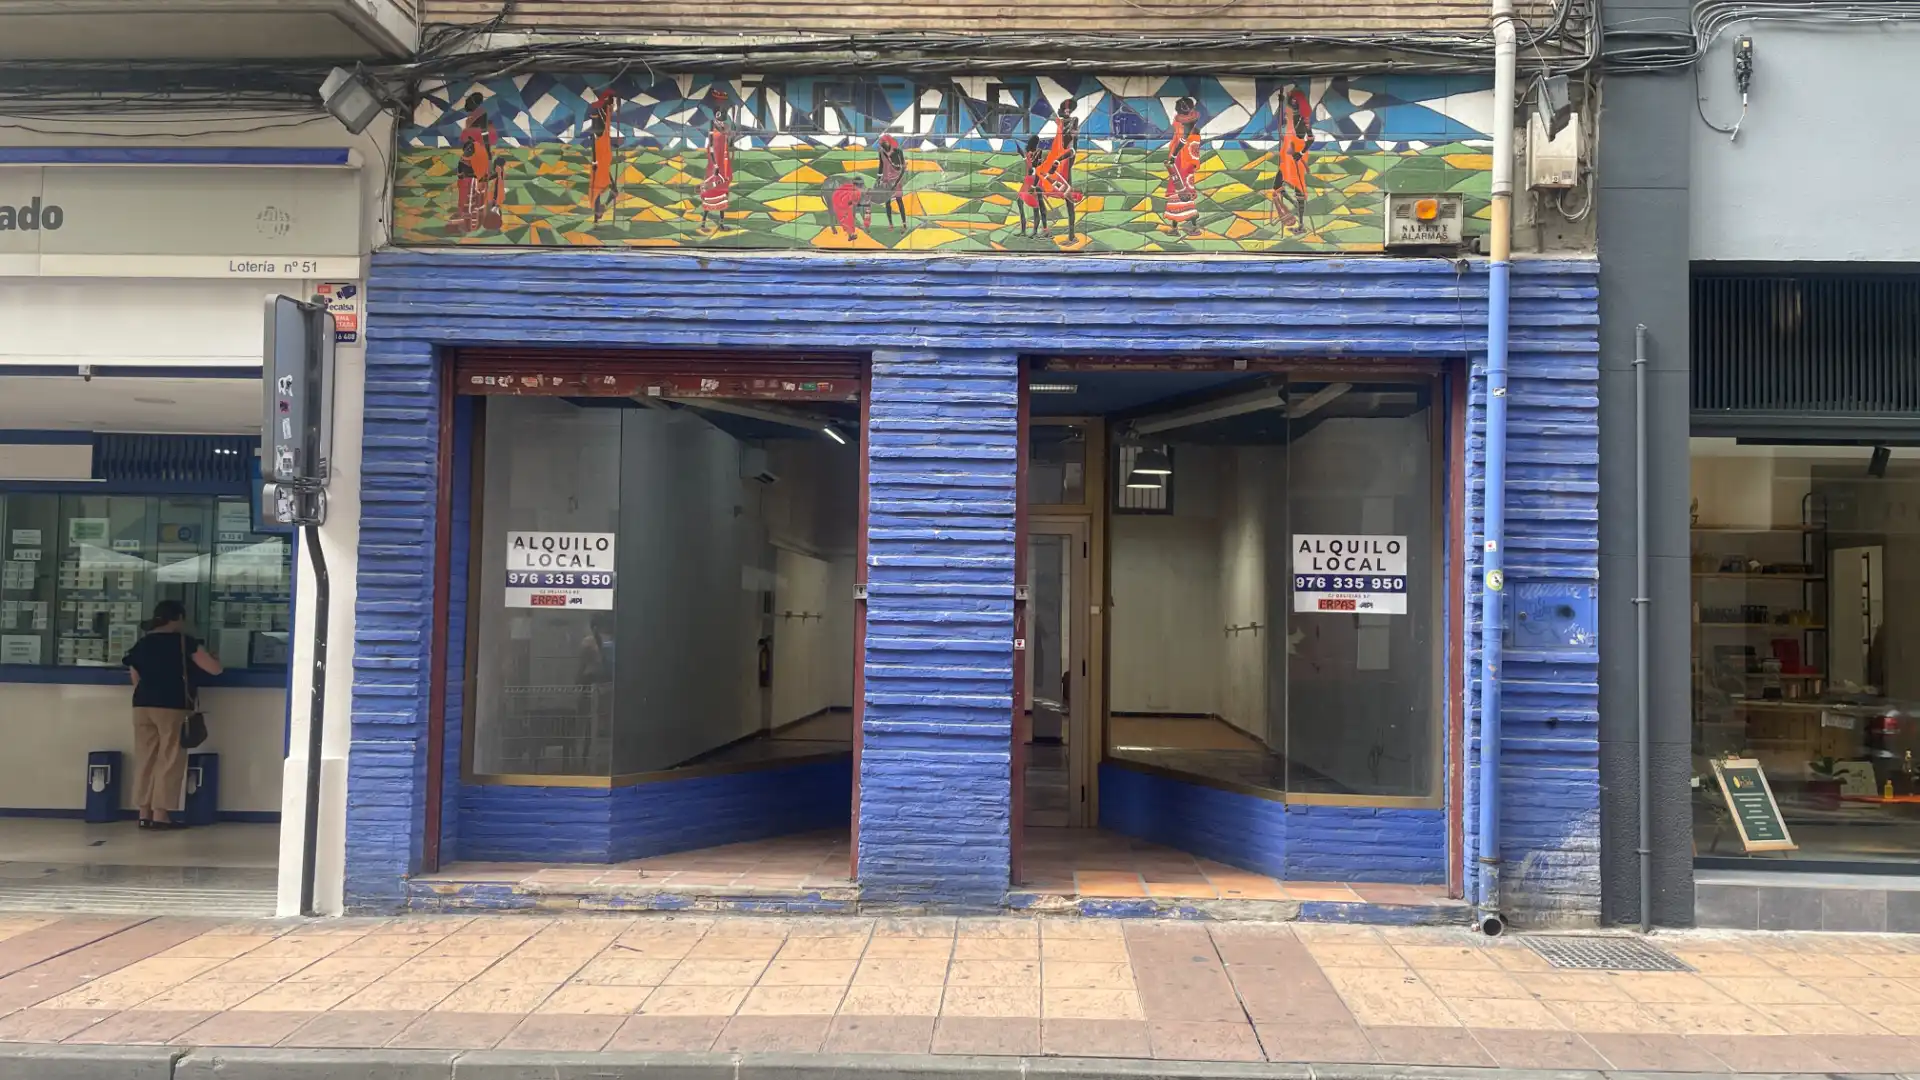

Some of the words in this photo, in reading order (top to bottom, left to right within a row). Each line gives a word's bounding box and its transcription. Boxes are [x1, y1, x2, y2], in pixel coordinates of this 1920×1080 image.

[0, 196, 64, 231] ado
[1401, 232, 1449, 240] ALARMAS
[302, 261, 317, 272] 51
[325, 303, 354, 311] ecalsa
[513, 536, 609, 552] ALQUILO
[1299, 540, 1401, 556] ALQUILO
[526, 553, 595, 567] LOCAL
[1313, 557, 1386, 571] LOCAL
[509, 573, 539, 584] 976
[545, 573, 574, 584] 335
[581, 574, 611, 585] 950
[1296, 577, 1326, 588] 976
[1333, 577, 1364, 588] 335
[1371, 578, 1403, 589] 950
[531, 595, 566, 606] ERPAS
[1319, 599, 1356, 610] ERPAS
